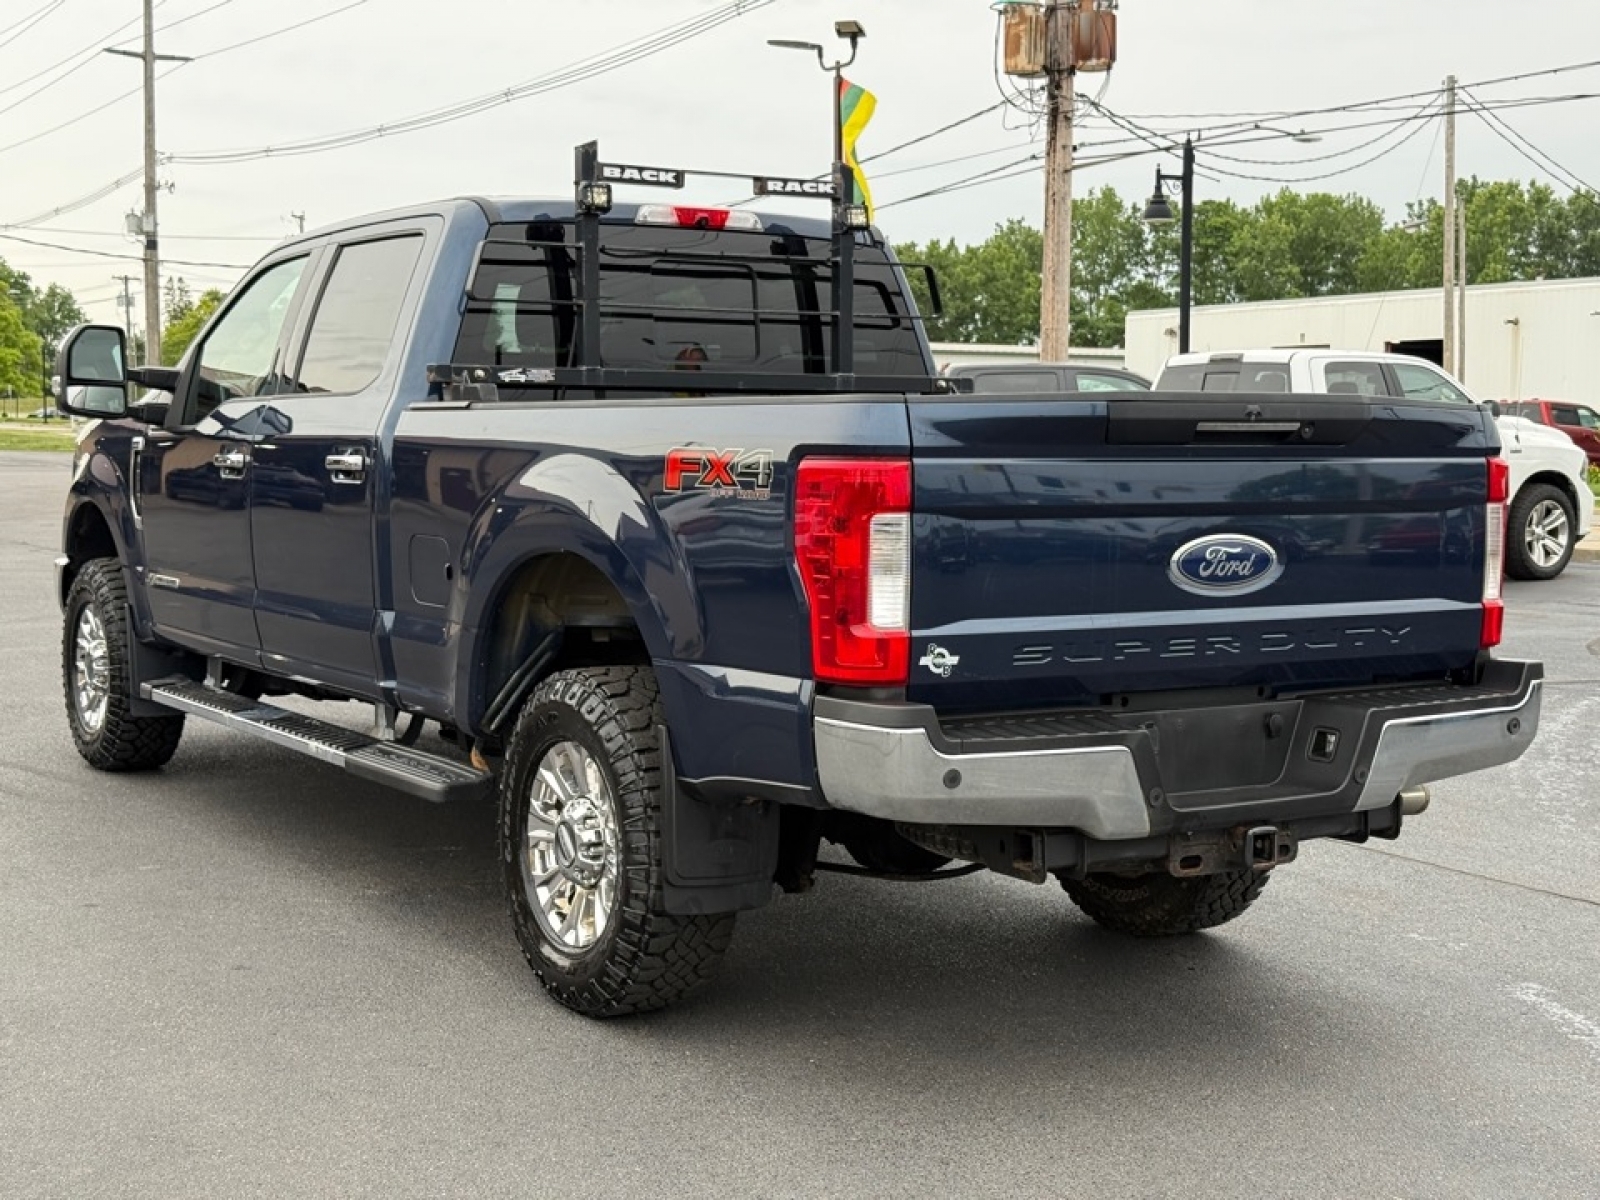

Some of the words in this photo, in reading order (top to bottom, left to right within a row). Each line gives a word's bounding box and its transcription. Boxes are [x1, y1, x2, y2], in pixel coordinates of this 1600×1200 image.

[602, 166, 677, 184] BACK
[766, 180, 835, 195] RACK
[663, 446, 774, 492] FX4
[1199, 546, 1255, 577] Ford
[1012, 637, 1241, 665] SUPER
[1259, 626, 1411, 653] DUTY
